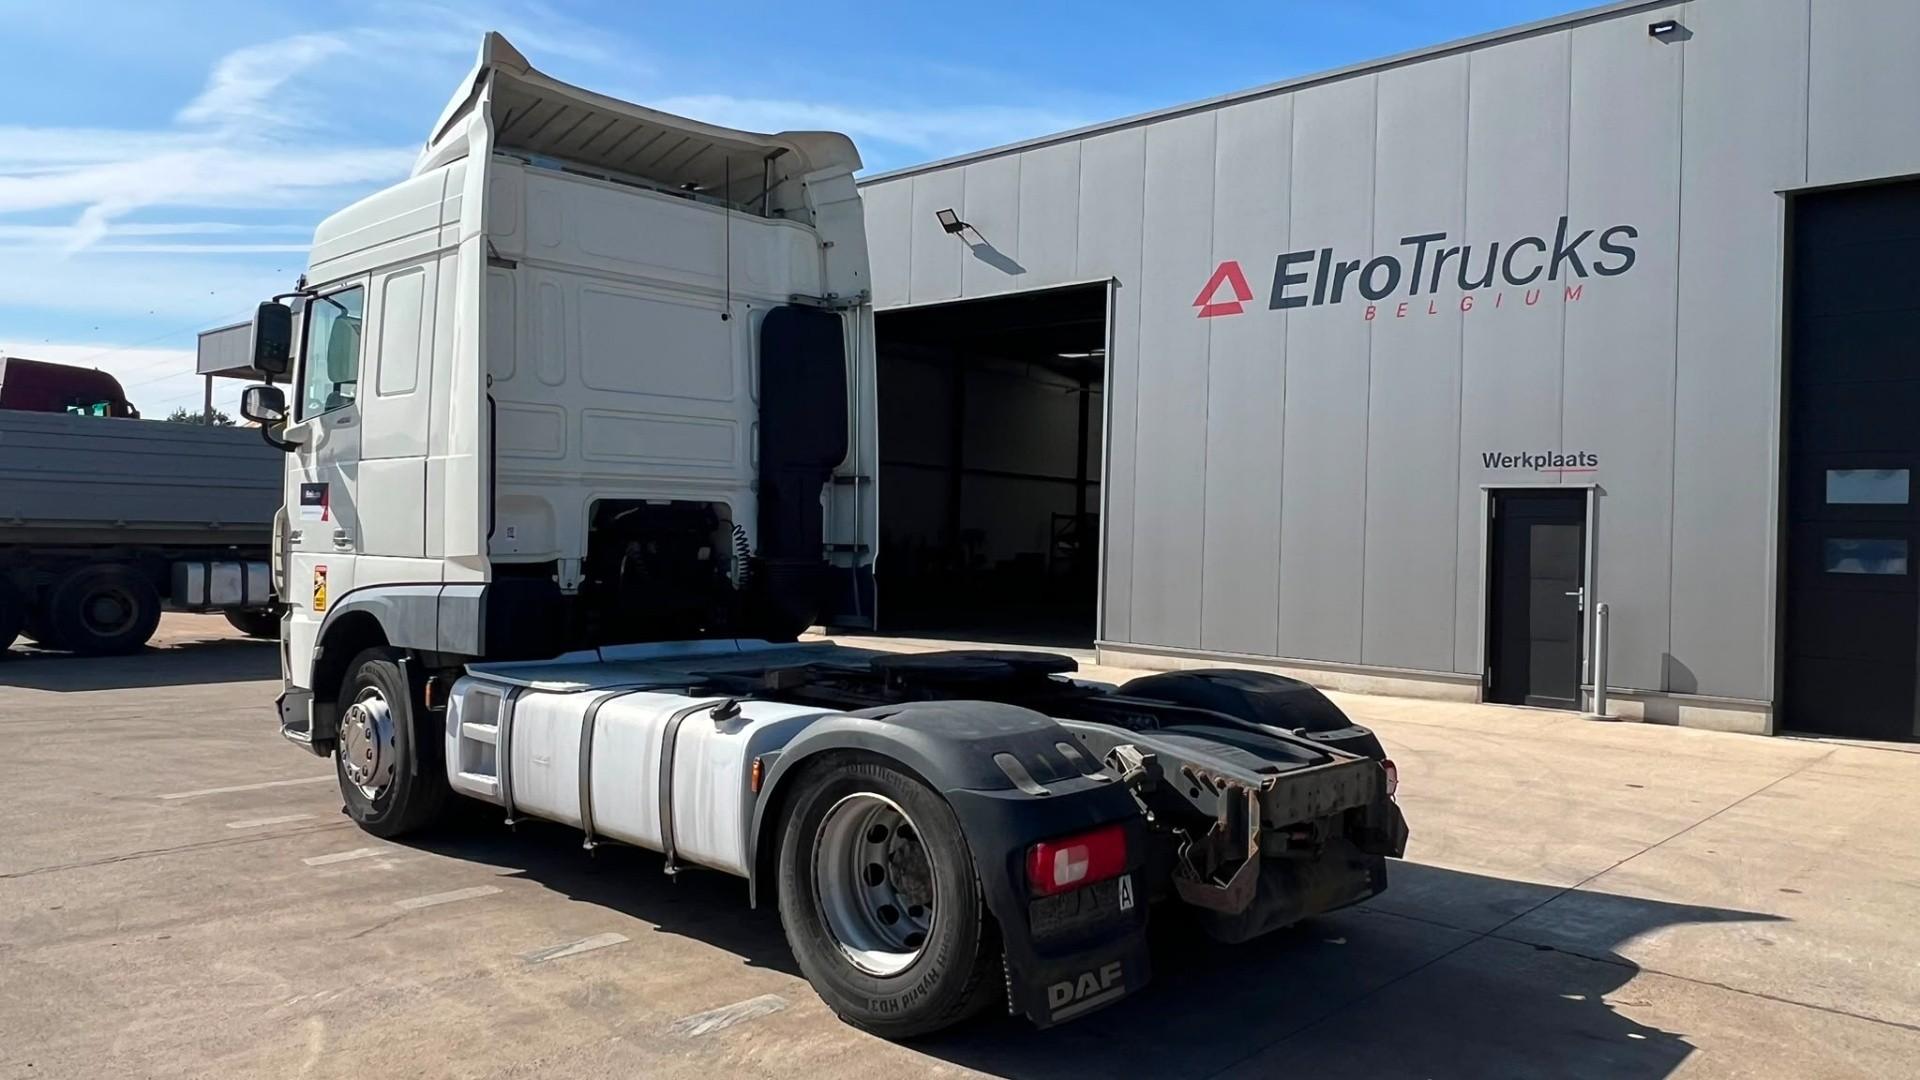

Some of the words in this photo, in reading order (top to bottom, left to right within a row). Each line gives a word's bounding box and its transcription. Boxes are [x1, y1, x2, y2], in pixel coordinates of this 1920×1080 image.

[1268, 215, 1639, 311] ElroTrucks
[1364, 284, 1584, 322] BELGIUM
[1482, 450, 1599, 470] Werkplaats
[1122, 876, 1133, 907] A
[901, 967, 941, 1009] Hybrid
[1047, 961, 1123, 1010] DAF
[870, 997, 900, 1013] HD3
